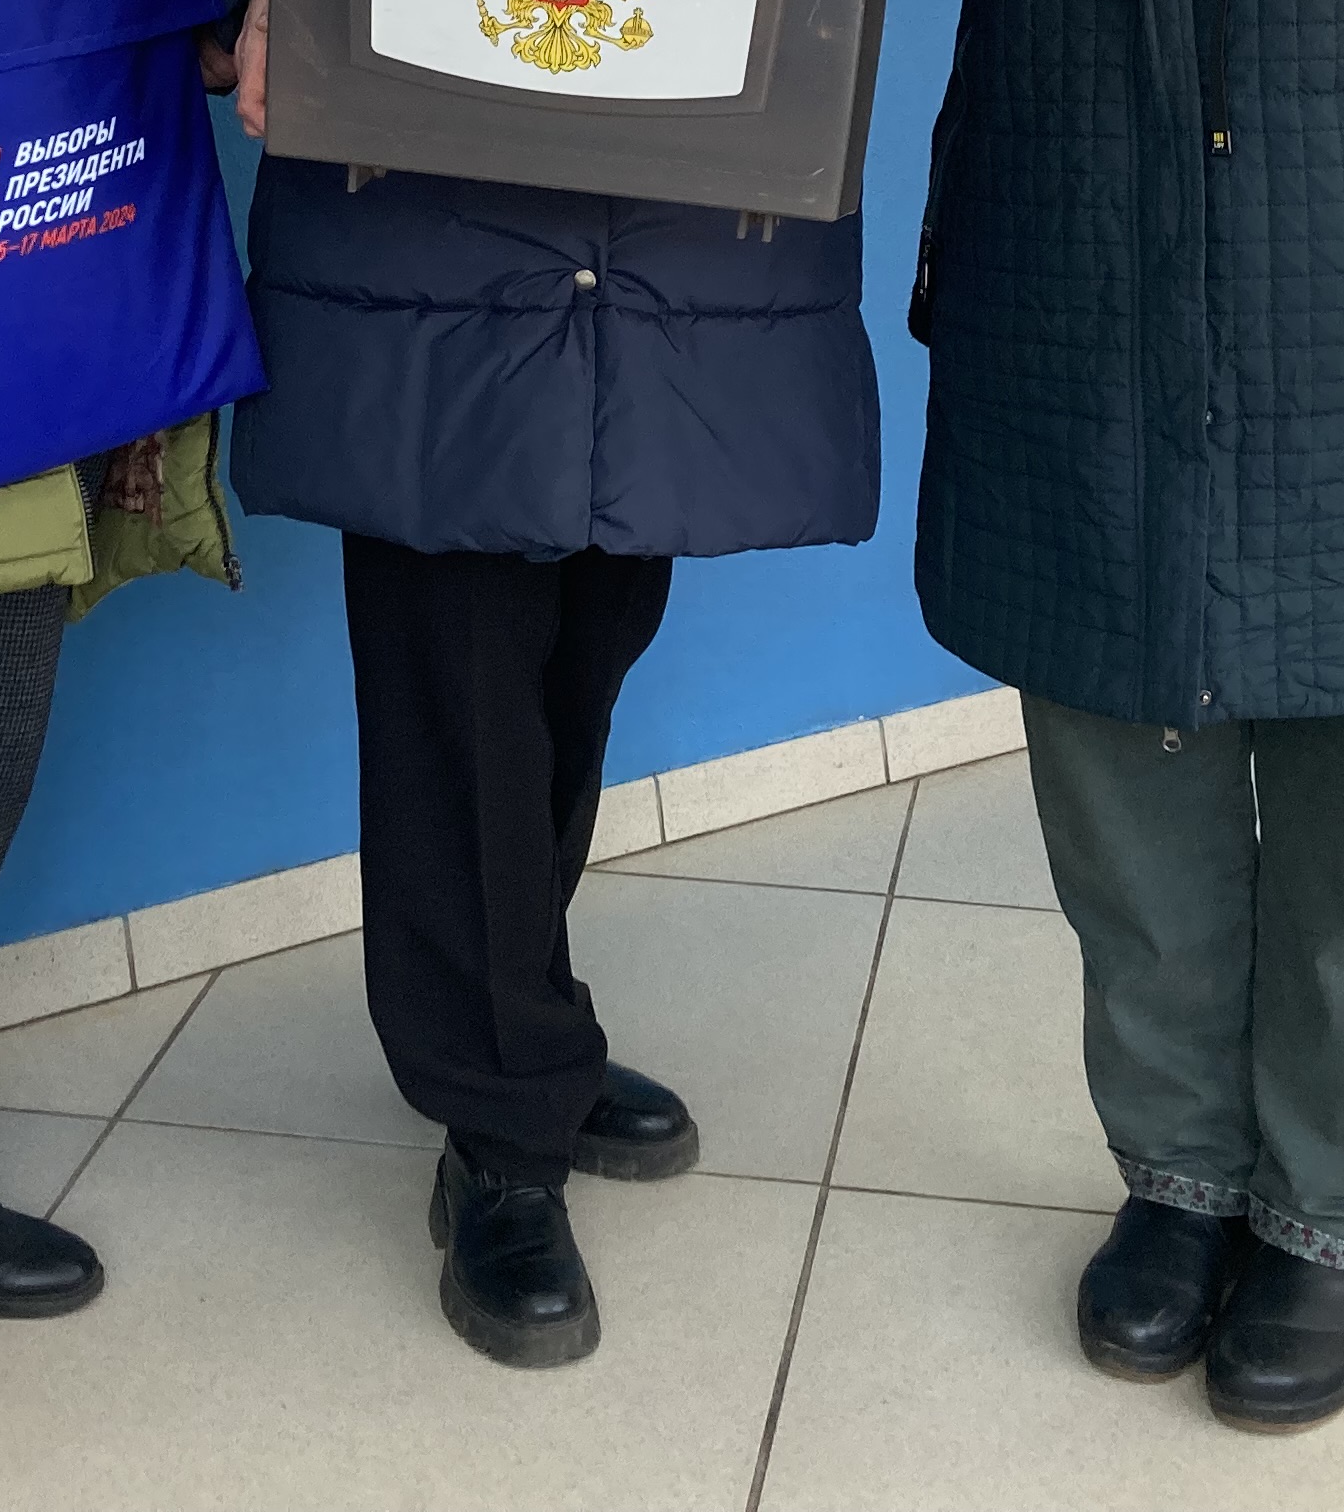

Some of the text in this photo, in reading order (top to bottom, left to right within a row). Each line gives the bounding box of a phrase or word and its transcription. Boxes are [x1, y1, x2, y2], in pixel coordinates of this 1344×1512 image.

[14, 116, 117, 168] ВЫБОРЫ
[4, 137, 145, 201] ПРЕЗИДЕНТА
[41, 216, 96, 250] МАРТА
[99, 203, 137, 232] 2024
